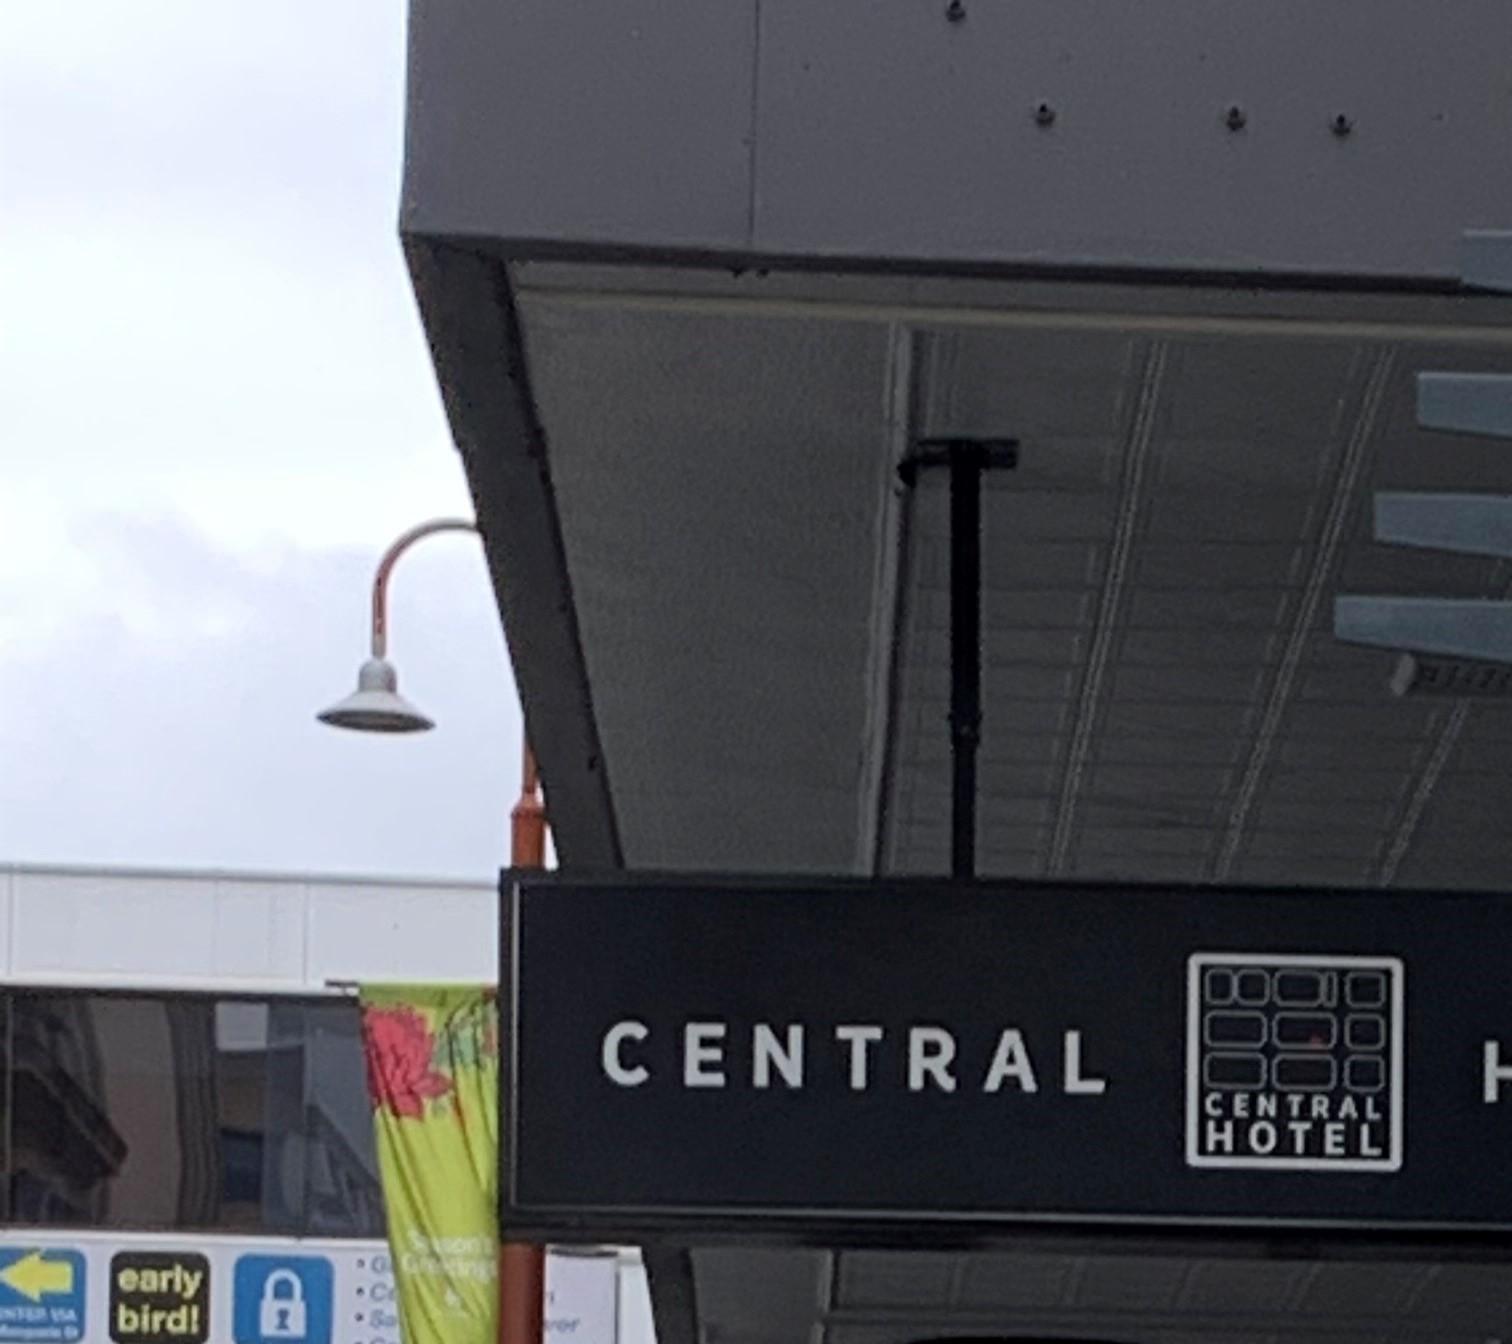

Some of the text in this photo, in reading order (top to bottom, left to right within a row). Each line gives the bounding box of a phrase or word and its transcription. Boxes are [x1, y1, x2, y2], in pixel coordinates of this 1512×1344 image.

[602, 1021, 1106, 1094] CENTRAL
[1204, 1092, 1382, 1120] CENTRAL
[1205, 1120, 1382, 1157] HOTEL
[118, 1263, 202, 1299] early
[117, 1303, 200, 1335] bird!
